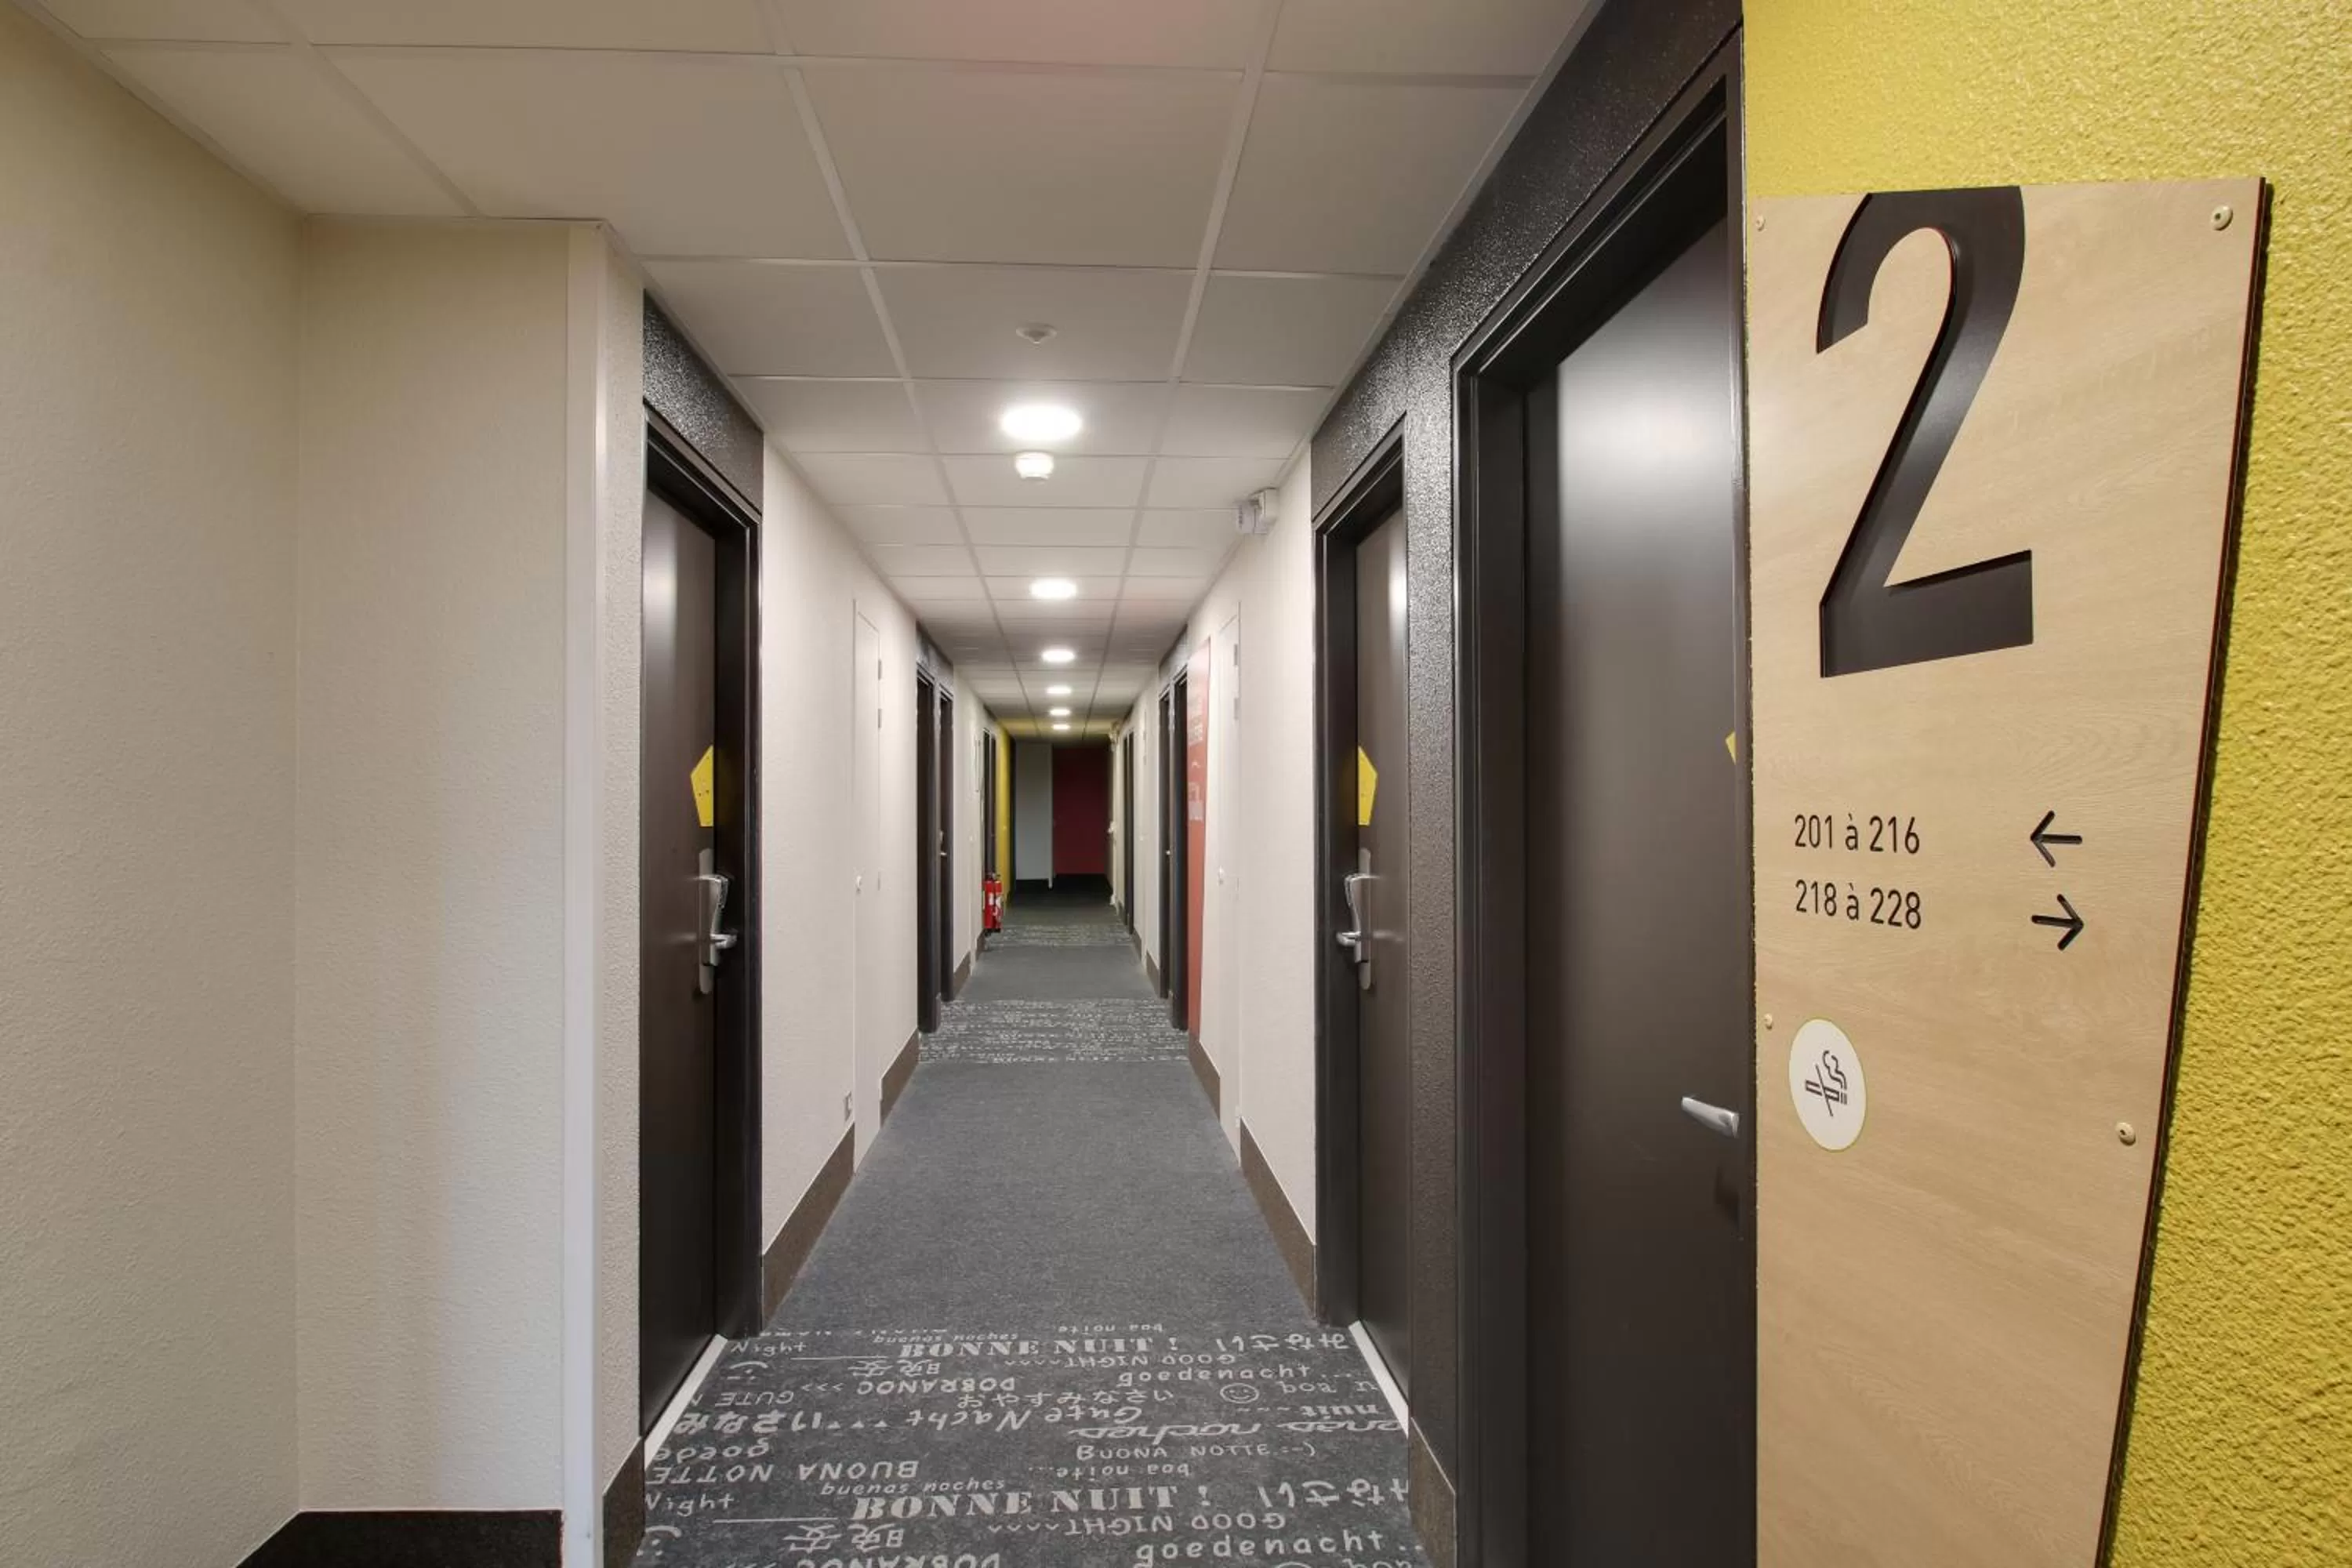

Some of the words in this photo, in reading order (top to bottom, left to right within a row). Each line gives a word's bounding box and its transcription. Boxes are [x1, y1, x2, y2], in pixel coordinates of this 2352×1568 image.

[1817, 186, 2034, 677] 2
[1795, 814, 1832, 849] 201
[1845, 812, 1858, 851] à
[1869, 815, 1920, 855] 216
[1795, 879, 1837, 916] 218
[1846, 882, 1859, 920] à
[1870, 887, 1921, 929] 228
[731, 1341, 807, 1357] Night
[899, 1341, 1040, 1357] BONNE
[1054, 1337, 1153, 1354] NUIT
[1162, 1353, 1236, 1366] GOOD
[857, 1377, 1015, 1395] DOBRANOC
[715, 1390, 794, 1407] GUTE
[906, 1409, 1032, 1432] Nacht
[1044, 1404, 1142, 1424] Gute
[1301, 1404, 1379, 1420] nuit
[1191, 1444, 1270, 1456] NOTTE
[645, 1464, 775, 1485] NOTTE
[798, 1461, 919, 1481] BUONA
[1148, 1463, 1190, 1477] boa
[821, 1483, 910, 1495] buenas
[922, 1477, 1005, 1492] noches
[644, 1492, 735, 1516] Night
[851, 1492, 1033, 1519] BONNE
[1051, 1486, 1178, 1512] NUIT
[1064, 1515, 1173, 1536] NIGHT
[1192, 1513, 1285, 1530] GOOD
